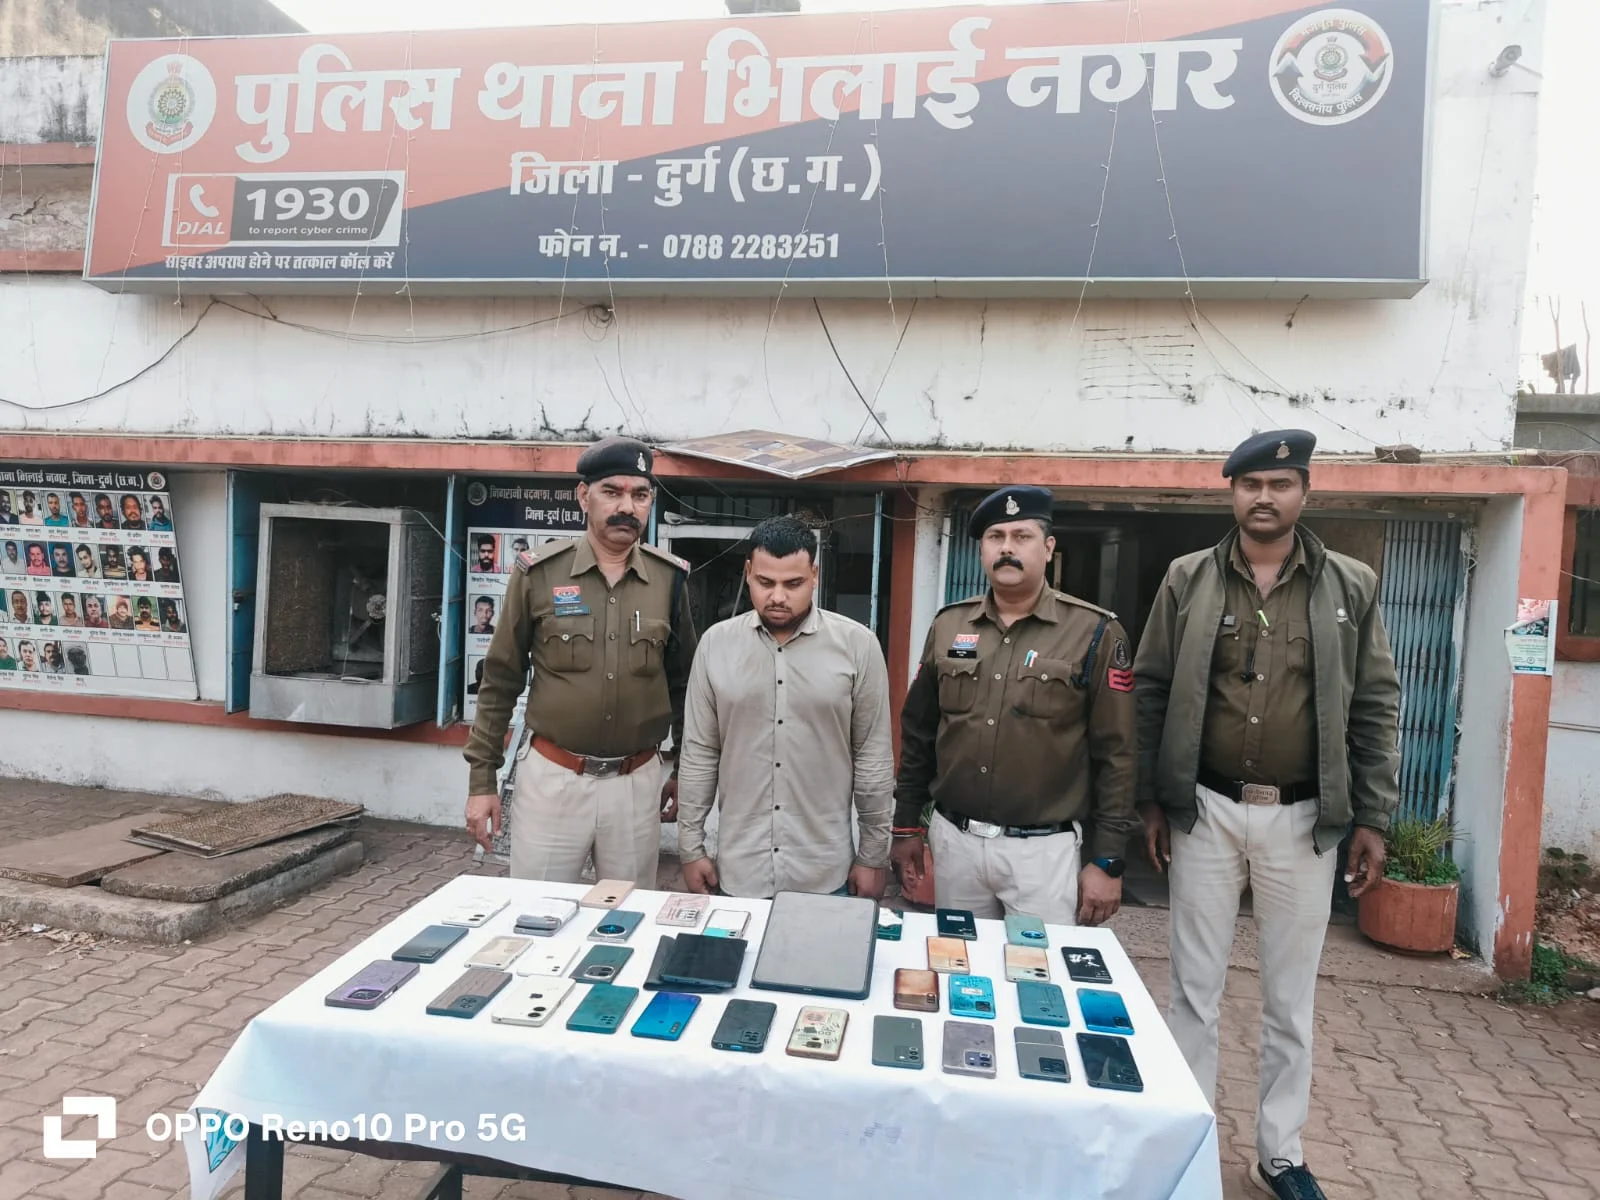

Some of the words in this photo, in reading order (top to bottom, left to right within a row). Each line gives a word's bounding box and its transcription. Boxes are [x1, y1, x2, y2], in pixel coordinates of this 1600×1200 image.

[235, 43, 461, 163] पुलिस
[478, 62, 683, 128] थाना
[701, 17, 992, 129] भिलाई
[1005, 38, 1243, 113] नगर
[510, 151, 619, 196] जिला
[654, 146, 721, 206] दुर्ग
[728, 144, 881, 202] (छ.ग.)
[246, 187, 370, 221] 1930
[176, 221, 225, 235] DIAL
[249, 226, 260, 235] to
[263, 226, 297, 238] report
[301, 226, 333, 237] cyber
[336, 226, 368, 235] crime
[538, 228, 594, 257] फोन
[599, 234, 628, 258] न.
[663, 234, 723, 259] 0788
[731, 233, 839, 259] 2283251
[165, 254, 204, 271] साइबर
[205, 255, 246, 270] अपराध
[249, 252, 272, 270] होने
[275, 255, 290, 269] पर
[293, 255, 337, 270] तत्काल
[340, 251, 370, 269] कॉल
[373, 251, 396, 270] करें
